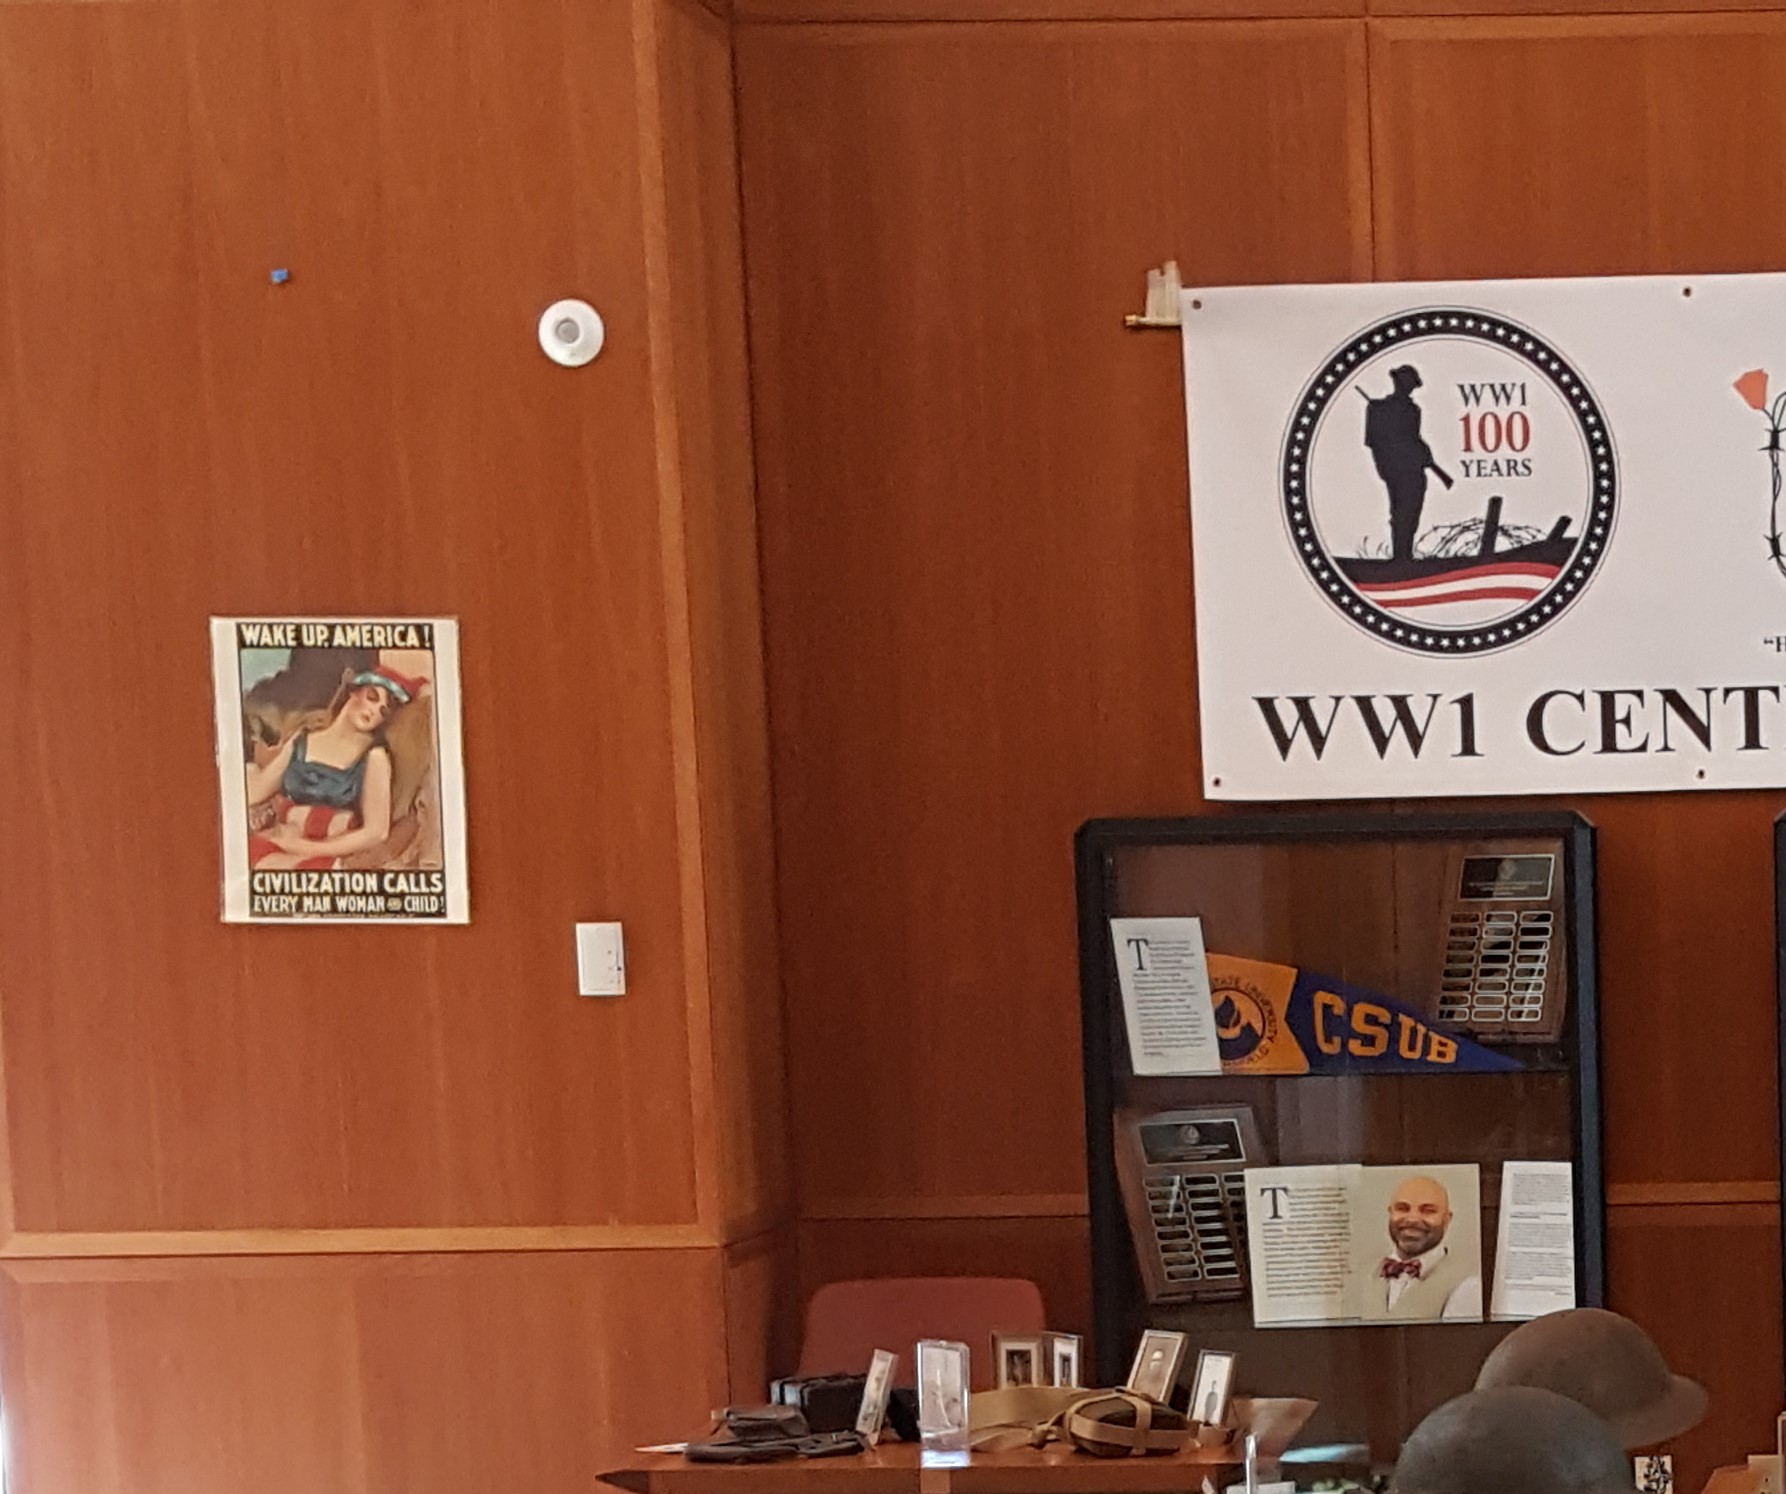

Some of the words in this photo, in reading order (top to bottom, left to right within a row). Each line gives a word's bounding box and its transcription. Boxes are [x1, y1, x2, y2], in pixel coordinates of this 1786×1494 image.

[1456, 382, 1527, 408] WW1
[1459, 411, 1531, 454] 100
[1460, 457, 1533, 478] YEARS
[241, 623, 297, 647] WAKE
[1252, 690, 1485, 762] WW1
[253, 872, 378, 894] CIVILIZATION
[383, 872, 444, 894] CALLS
[253, 895, 298, 913] EVERY
[303, 895, 332, 913] MAN
[335, 895, 386, 913] WOMAN
[404, 895, 446, 913] CHILD!
[1313, 990, 1458, 1064] CSUB
